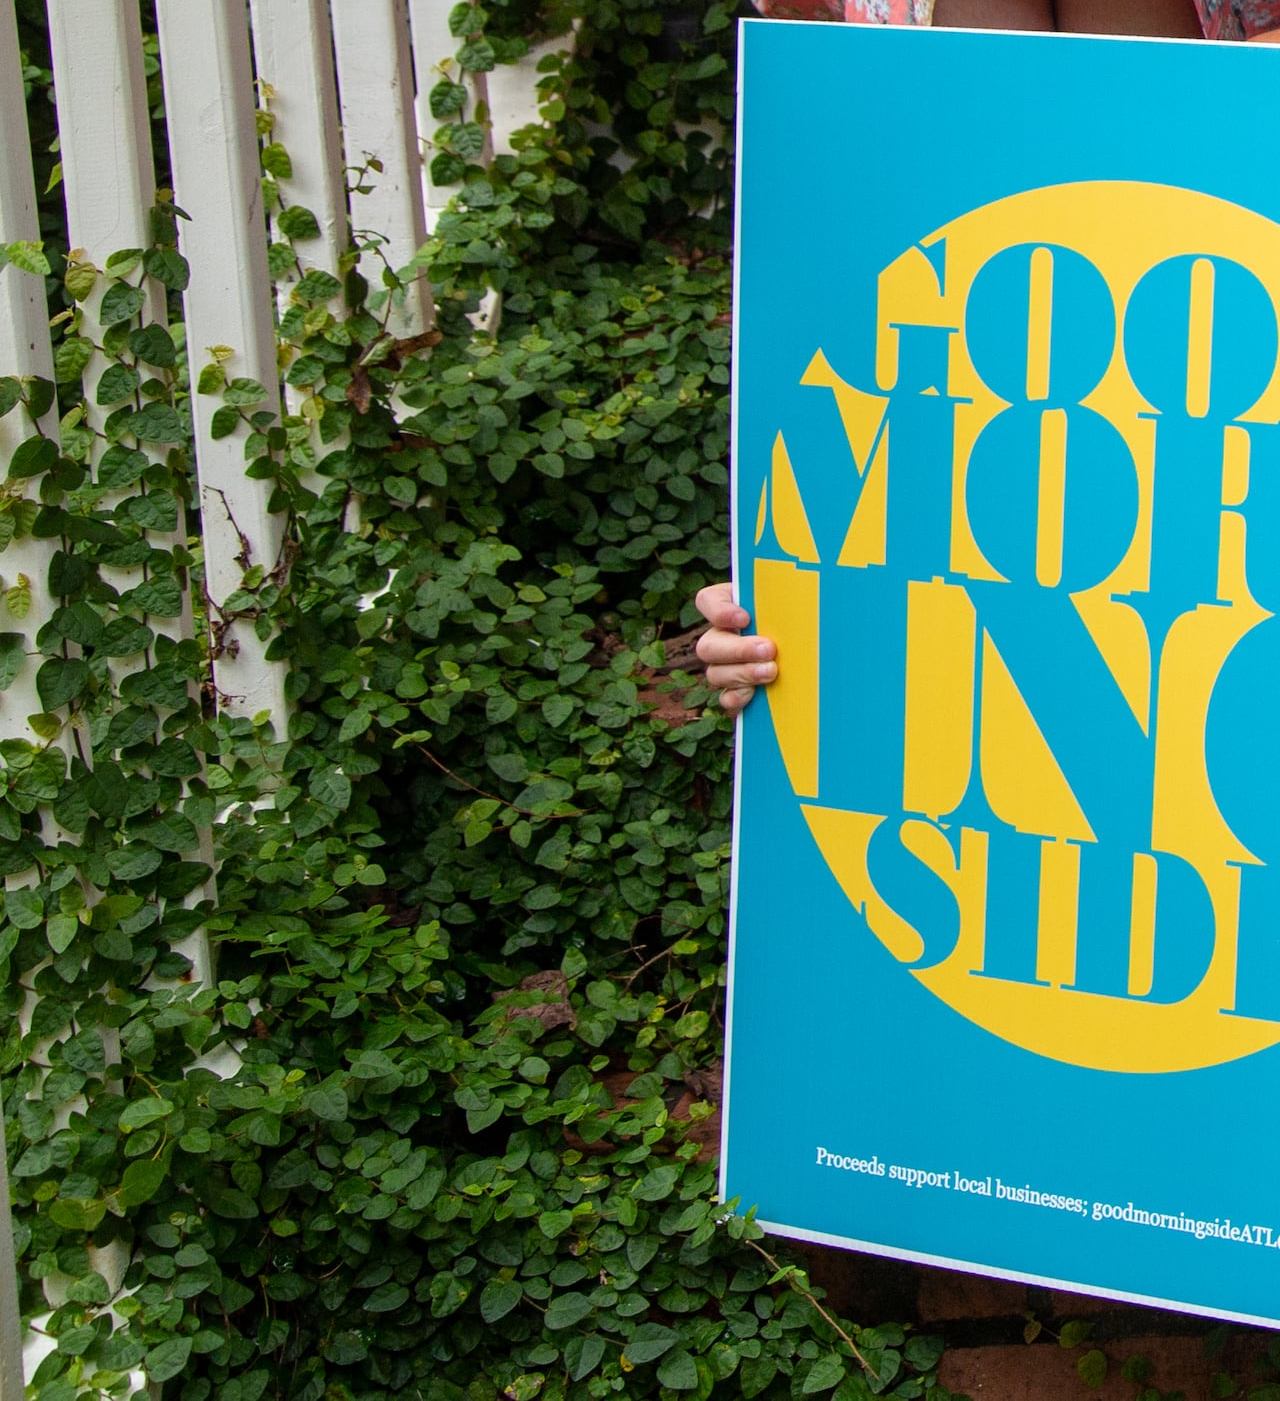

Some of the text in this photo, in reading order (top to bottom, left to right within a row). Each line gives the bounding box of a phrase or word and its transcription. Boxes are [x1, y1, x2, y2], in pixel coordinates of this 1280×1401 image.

[815, 1146, 886, 1177] Proceeds
[888, 1163, 951, 1189] support
[953, 1170, 992, 1197] local
[995, 1178, 1088, 1217] businesses;
